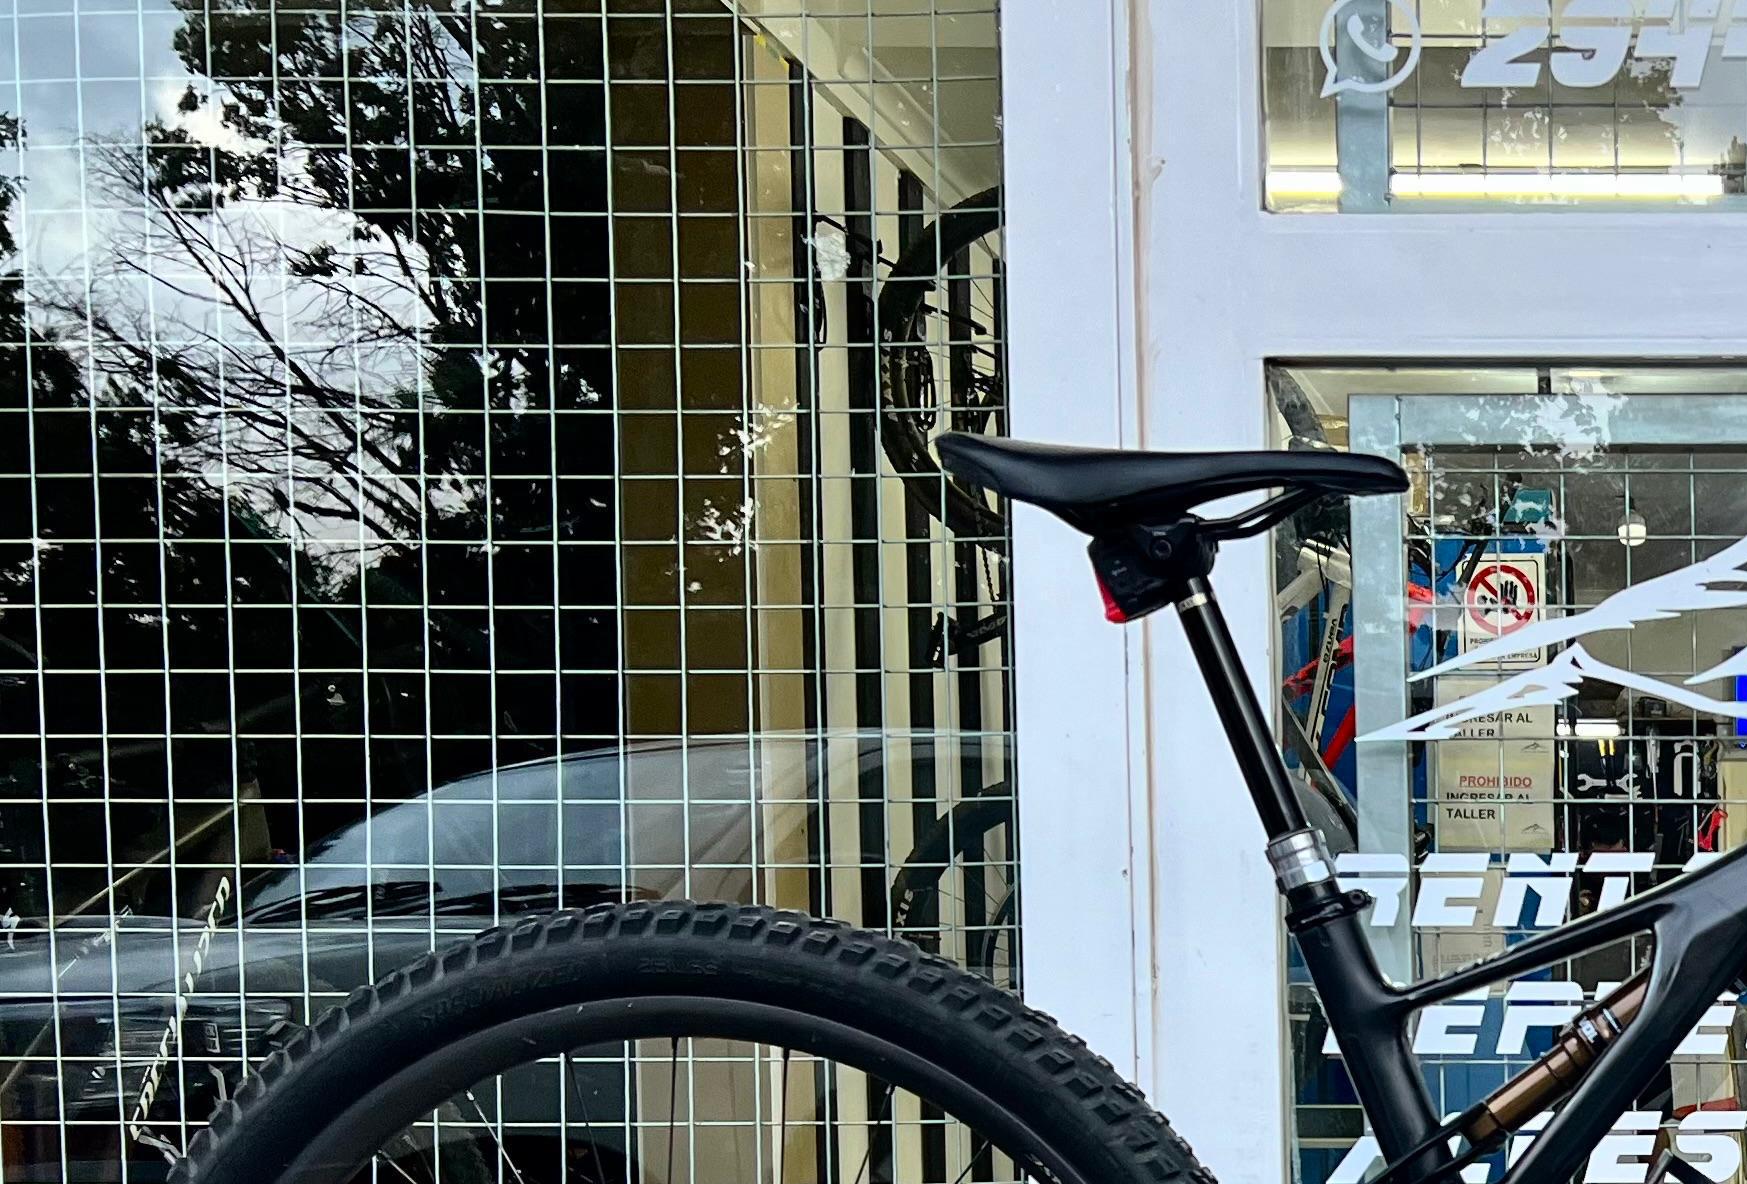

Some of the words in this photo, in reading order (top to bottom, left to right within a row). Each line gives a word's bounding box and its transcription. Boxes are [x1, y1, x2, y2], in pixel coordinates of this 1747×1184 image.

[1516, 713, 1533, 723] AL
[1459, 775, 1532, 788] PROHIBIDO
[1446, 808, 1496, 820] TALLER
